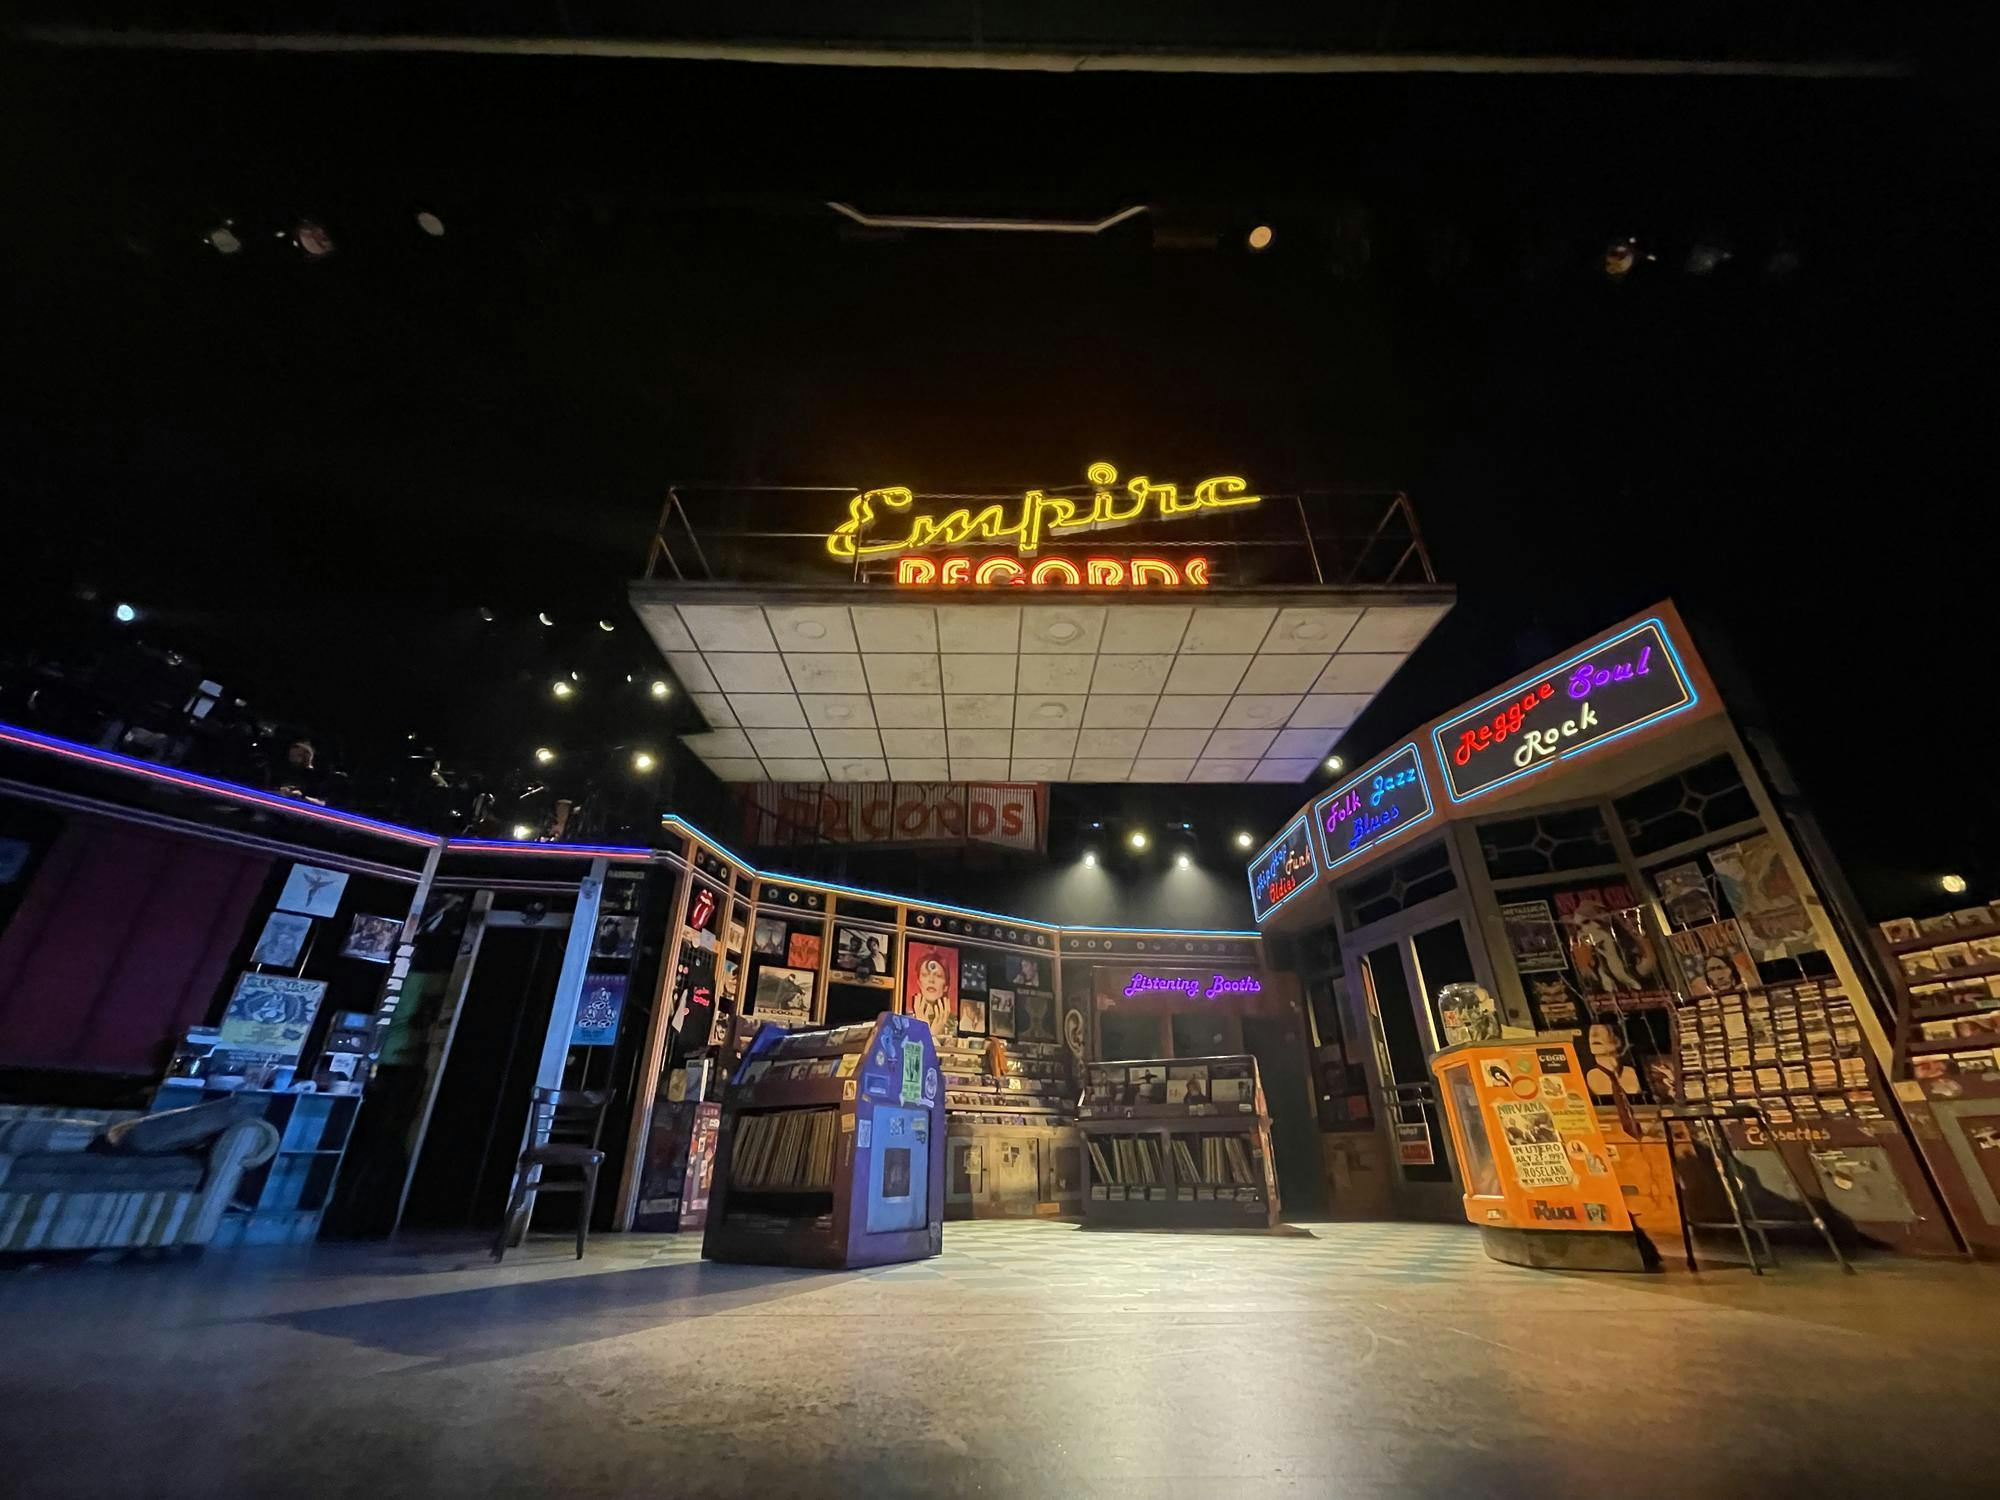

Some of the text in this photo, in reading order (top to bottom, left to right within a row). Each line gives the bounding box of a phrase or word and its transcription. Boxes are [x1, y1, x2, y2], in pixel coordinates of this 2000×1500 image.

[827, 461, 1261, 555] Empire
[1454, 645, 1651, 766] Reggae Soul
[1514, 702, 1598, 767] Rock
[1326, 768, 1416, 833] Folk Jazz
[1349, 804, 1399, 850] Blues
[1286, 844, 1311, 875] Funk
[1269, 875, 1296, 903] Oldies
[1124, 973, 1261, 998] Listening Booths
[1539, 1054, 1566, 1062] CBGB
[1497, 1101, 1546, 1115] NIRVANA
[1512, 1143, 1561, 1155] IN UTERO
[1523, 1165, 1566, 1177] ROSELAND
